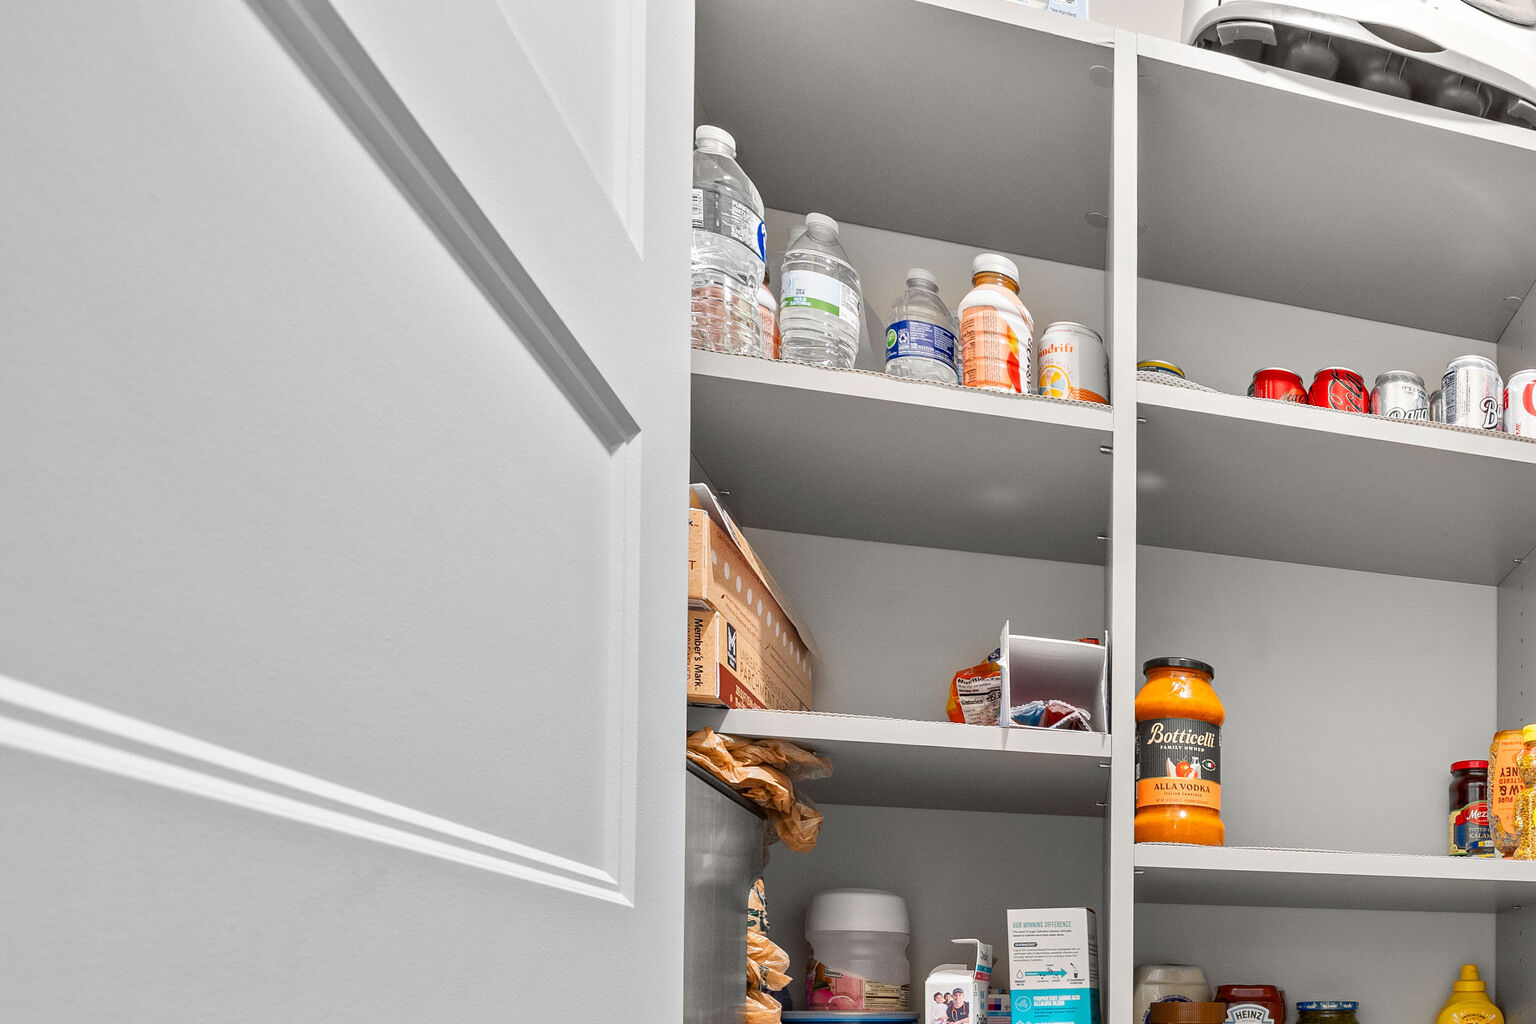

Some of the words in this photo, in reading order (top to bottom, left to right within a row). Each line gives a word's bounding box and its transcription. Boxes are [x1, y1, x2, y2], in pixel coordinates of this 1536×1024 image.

[694, 618, 704, 662] Member's
[694, 664, 704, 687] Mark
[1147, 722, 1216, 748] Botticelli
[1154, 783, 1178, 791] ALLA
[1180, 783, 1211, 794] VODKA
[1044, 920, 1072, 928] DIFFERENCE
[1235, 1009, 1263, 1021] HEINZ
